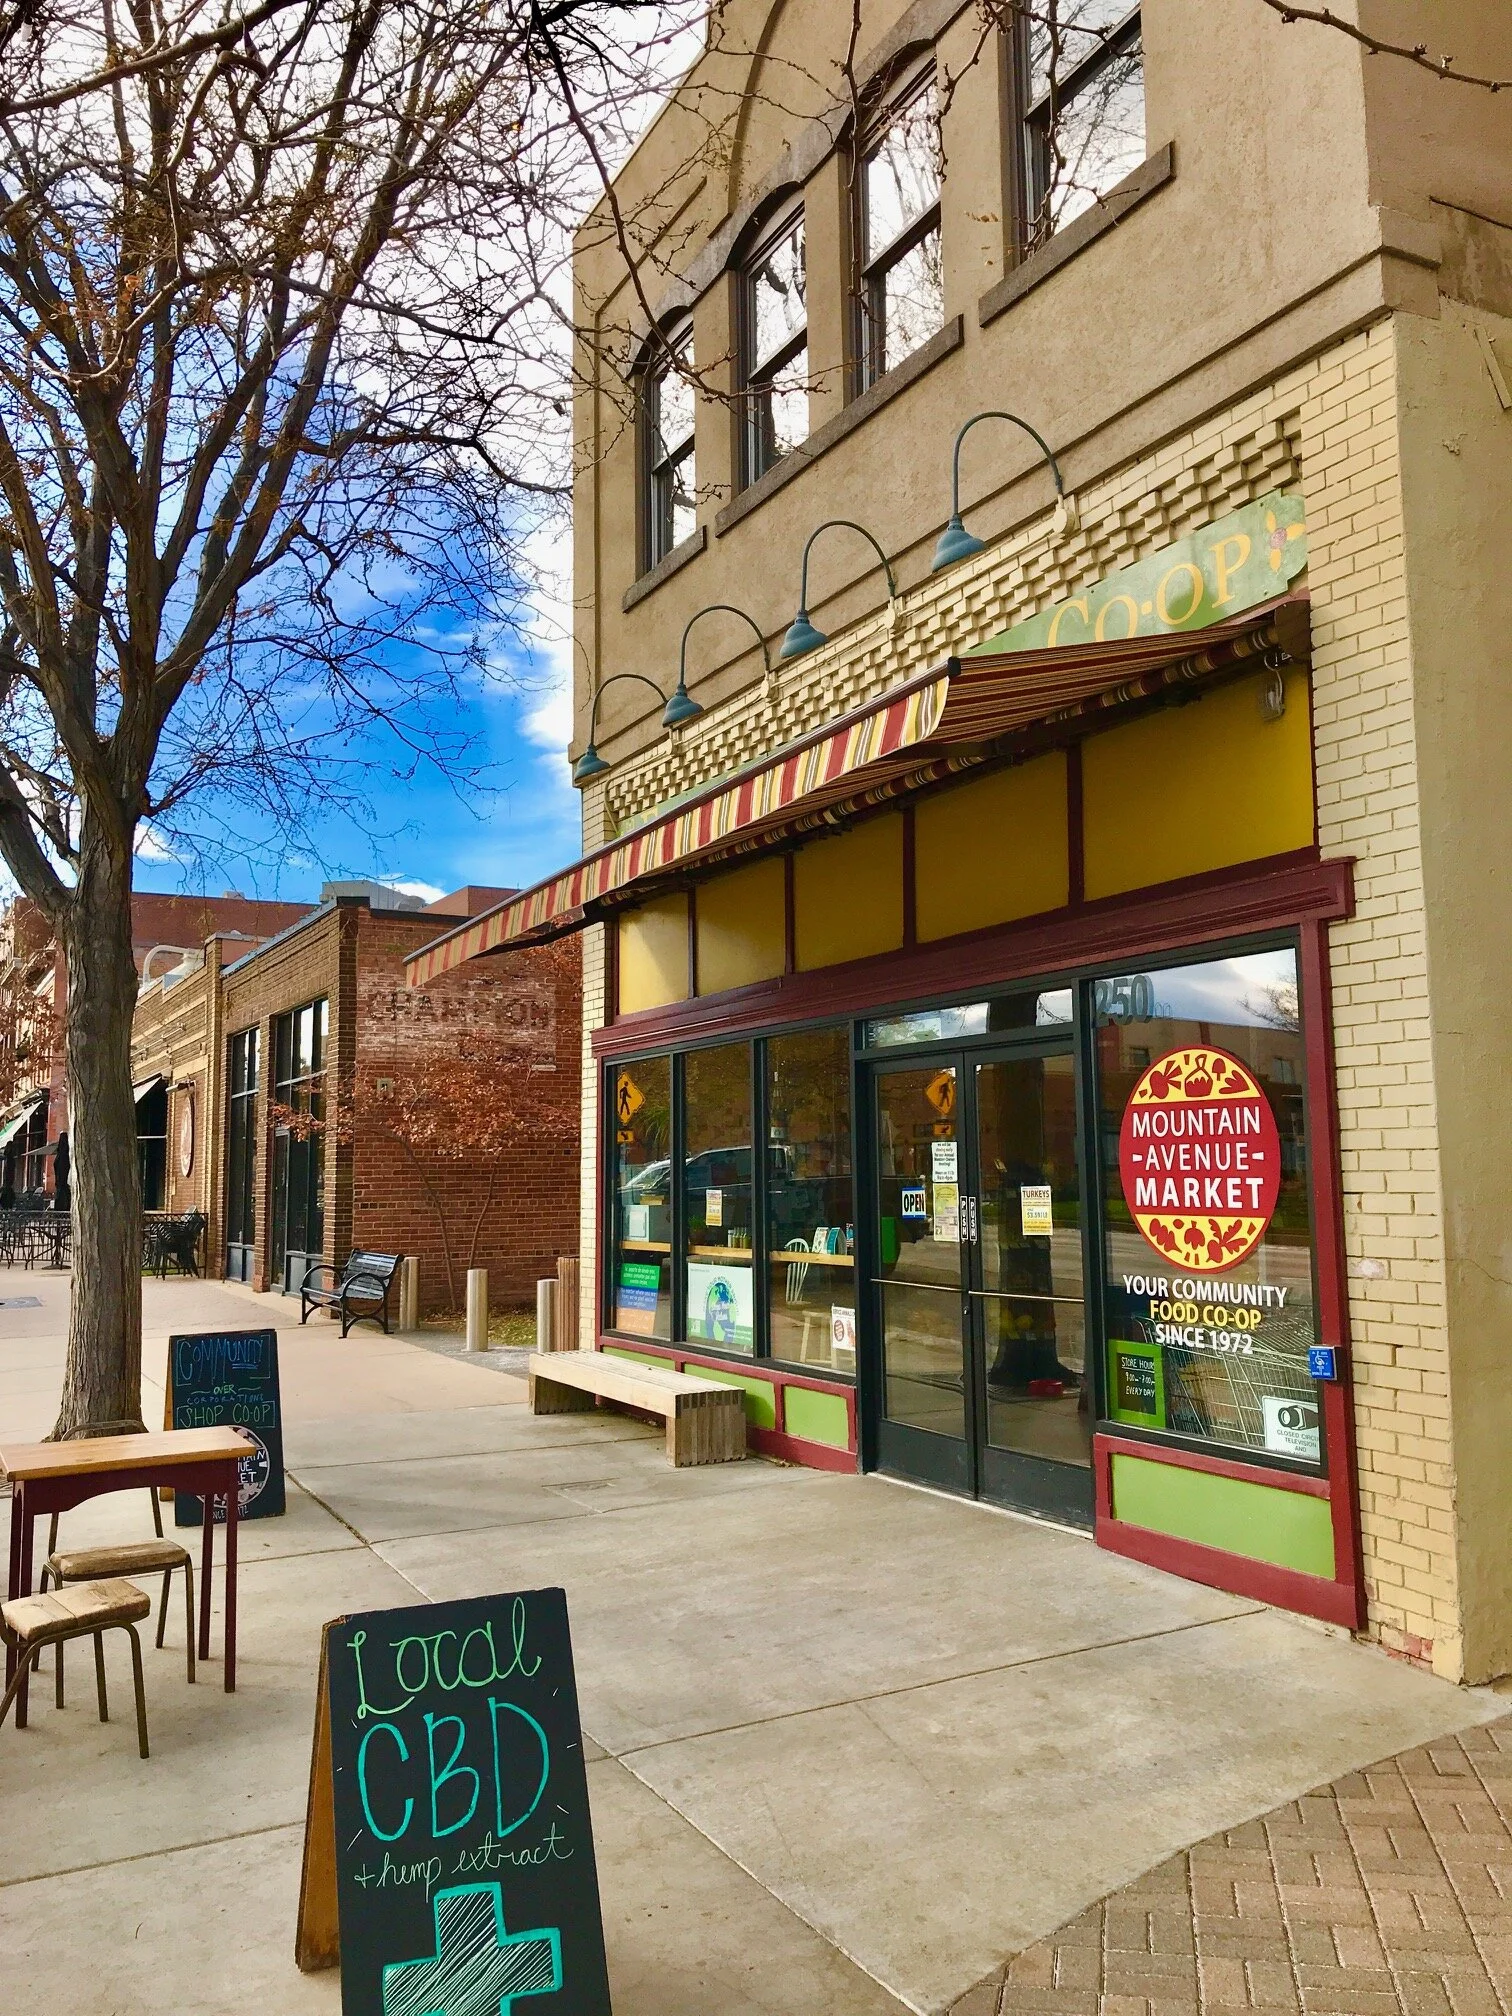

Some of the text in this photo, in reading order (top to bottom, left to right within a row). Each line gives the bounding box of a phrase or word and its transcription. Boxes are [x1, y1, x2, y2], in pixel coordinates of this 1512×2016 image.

[1095, 974, 1154, 1026] 250
[1132, 1105, 1261, 1138] MOUNTAIN
[903, 1193, 925, 1213] OPEN
[1022, 1190, 1050, 1198] TURKEYS
[1135, 1177, 1264, 1209] MARKET
[1122, 1274, 1288, 1308] YOUR COMMUNITY
[1150, 1299, 1262, 1331] FOOD CO-OP
[1155, 1323, 1253, 1355] SINCE 1972
[1121, 1356, 1138, 1368] STORE
[213, 1384, 237, 1395] OVER
[180, 1405, 224, 1428] SHOP
[1277, 1429, 1300, 1438] CLOSED
[1285, 1437, 1317, 1448] TELEVISION
[346, 1596, 543, 1720] Local
[357, 1697, 550, 1842] CBD
[376, 1851, 443, 1904] hemp
[450, 1822, 575, 1876] extract
